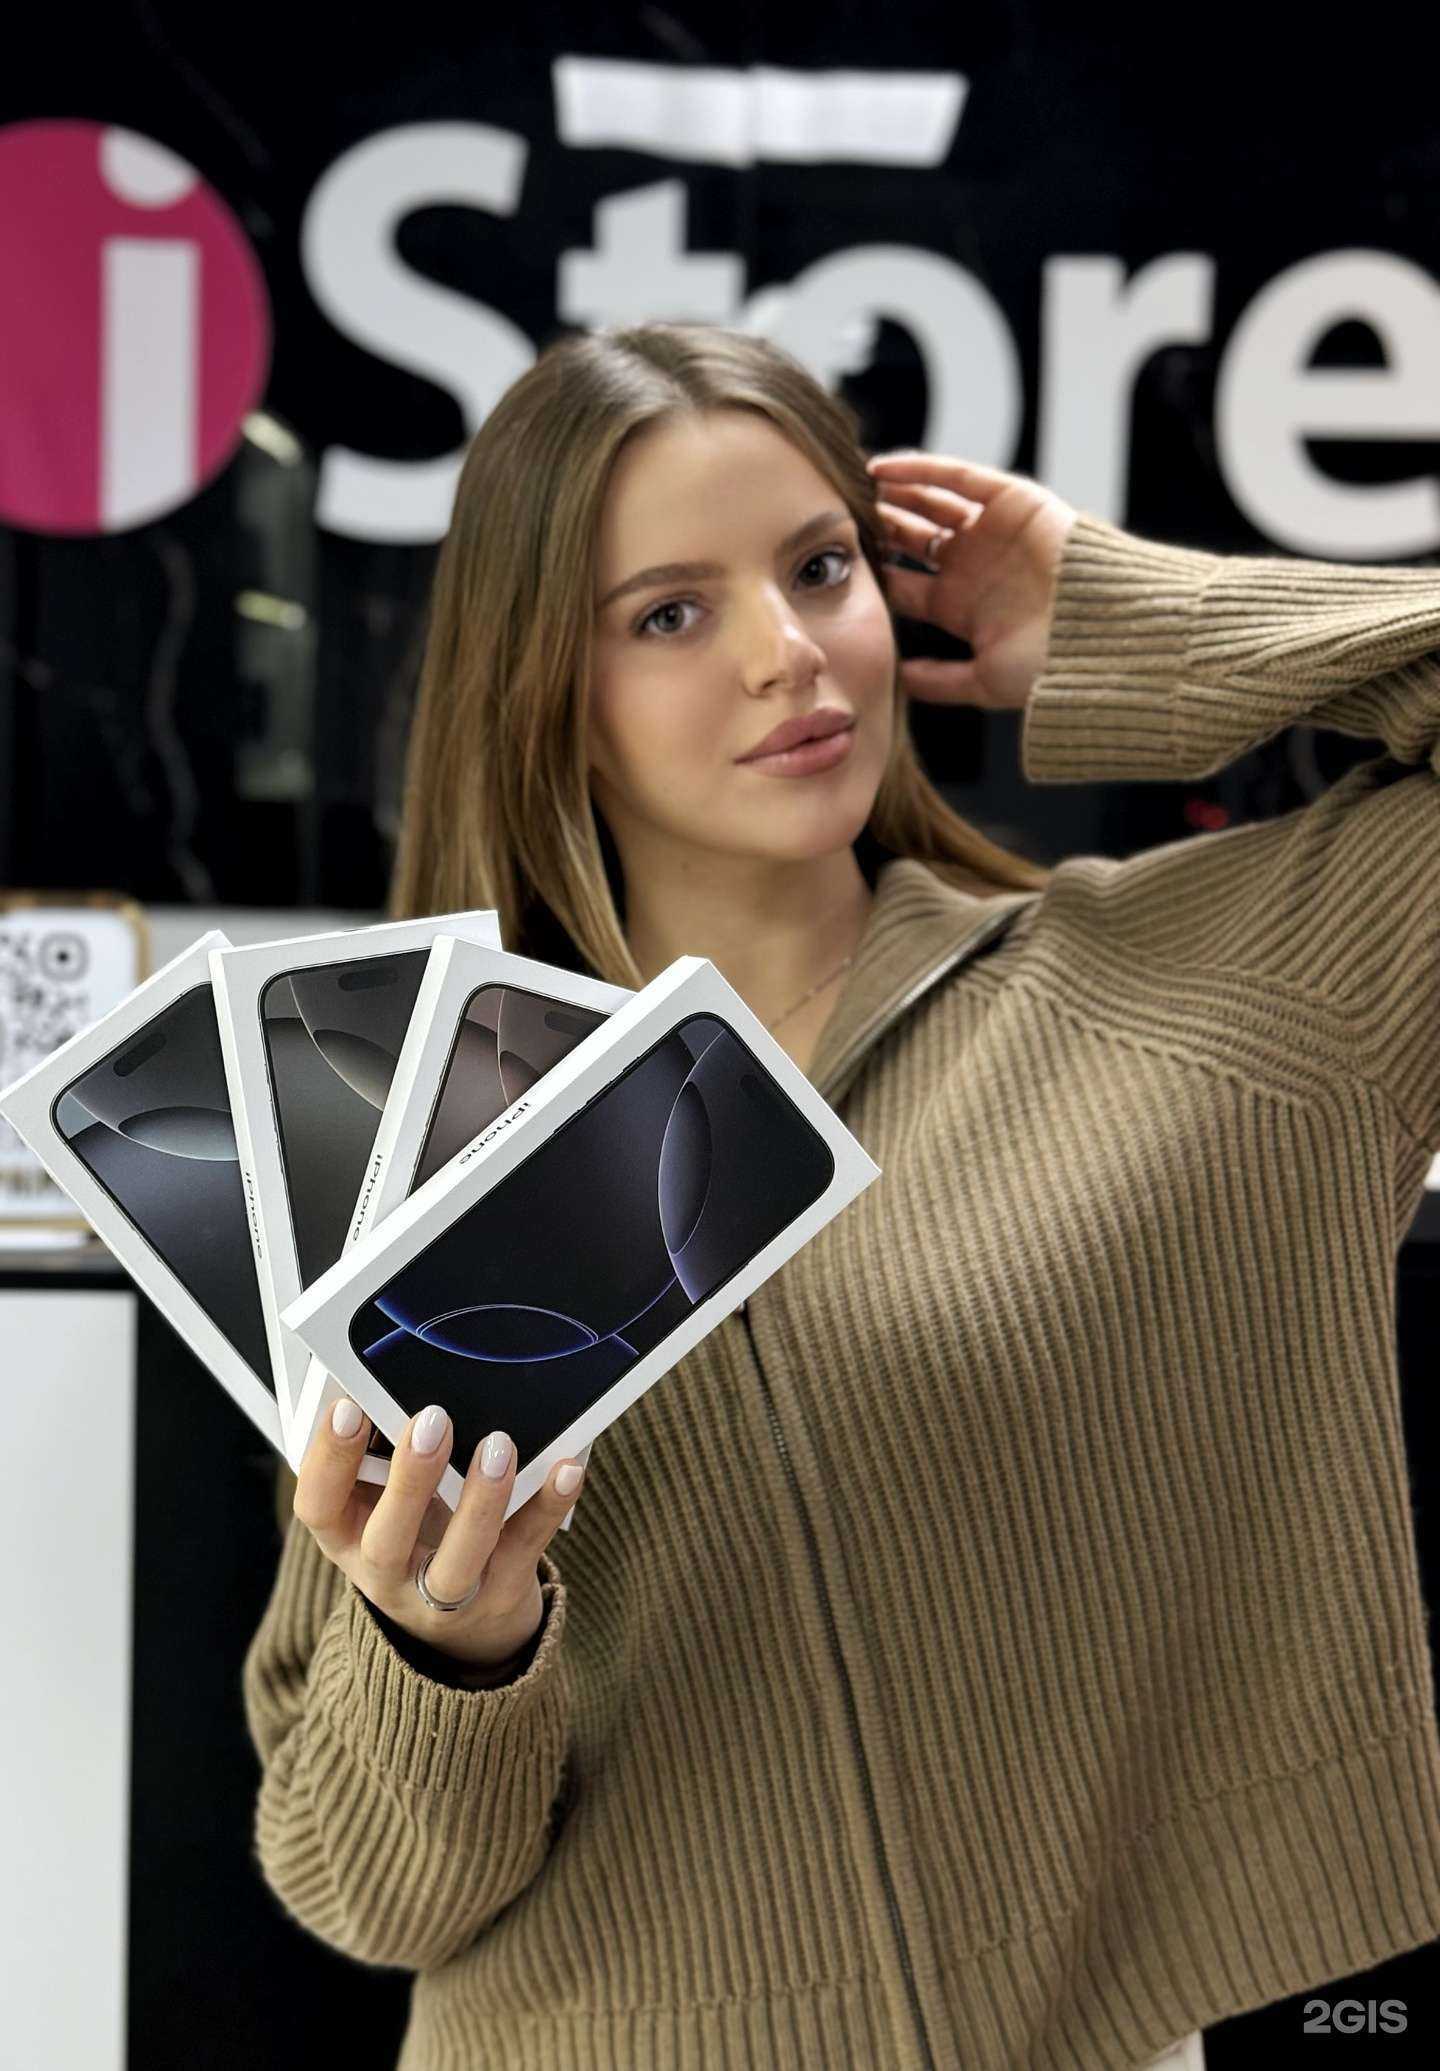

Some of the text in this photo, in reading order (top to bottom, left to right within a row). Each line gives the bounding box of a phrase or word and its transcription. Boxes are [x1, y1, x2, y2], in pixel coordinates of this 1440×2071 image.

[460, 1102, 530, 1164] iPhone
[245, 1172, 262, 1259] iPhone
[353, 1154, 382, 1241] iPhone
